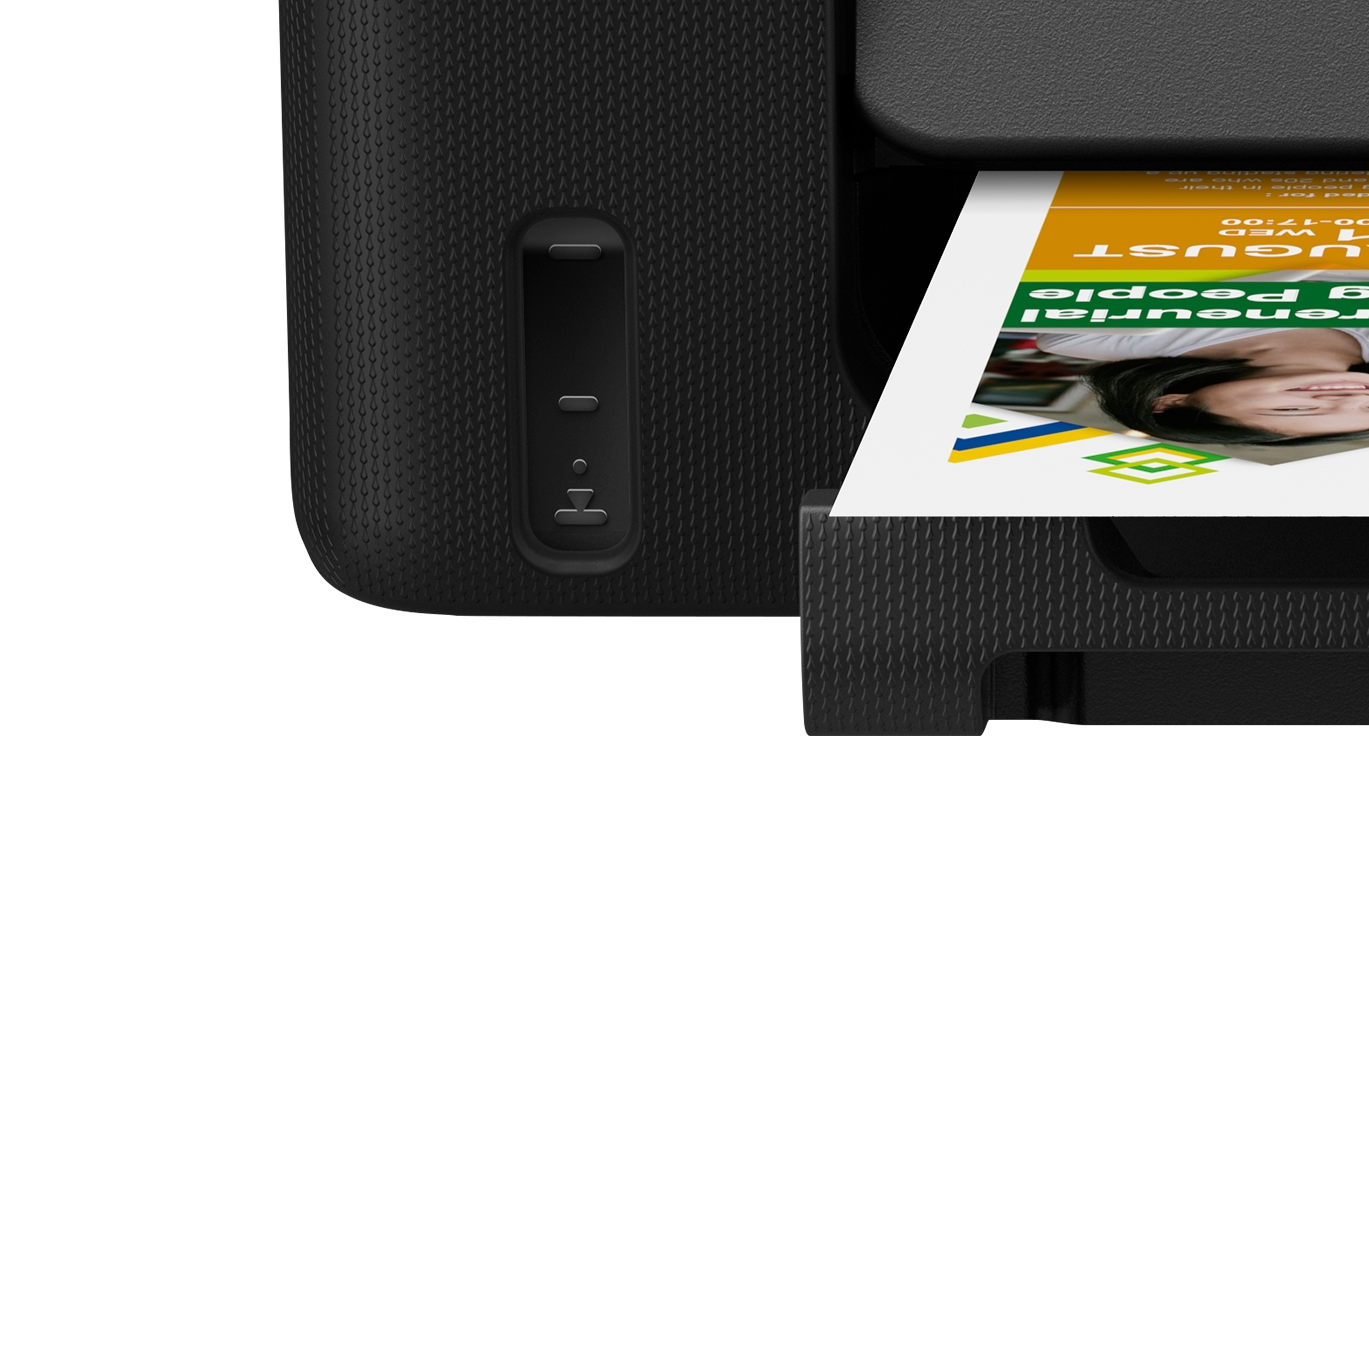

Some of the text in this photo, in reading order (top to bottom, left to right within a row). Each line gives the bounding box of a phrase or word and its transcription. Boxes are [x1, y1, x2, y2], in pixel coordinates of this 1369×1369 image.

[1270, 183, 1354, 191] people
[1217, 228, 1316, 237] WED
[1028, 285, 1300, 303] People
